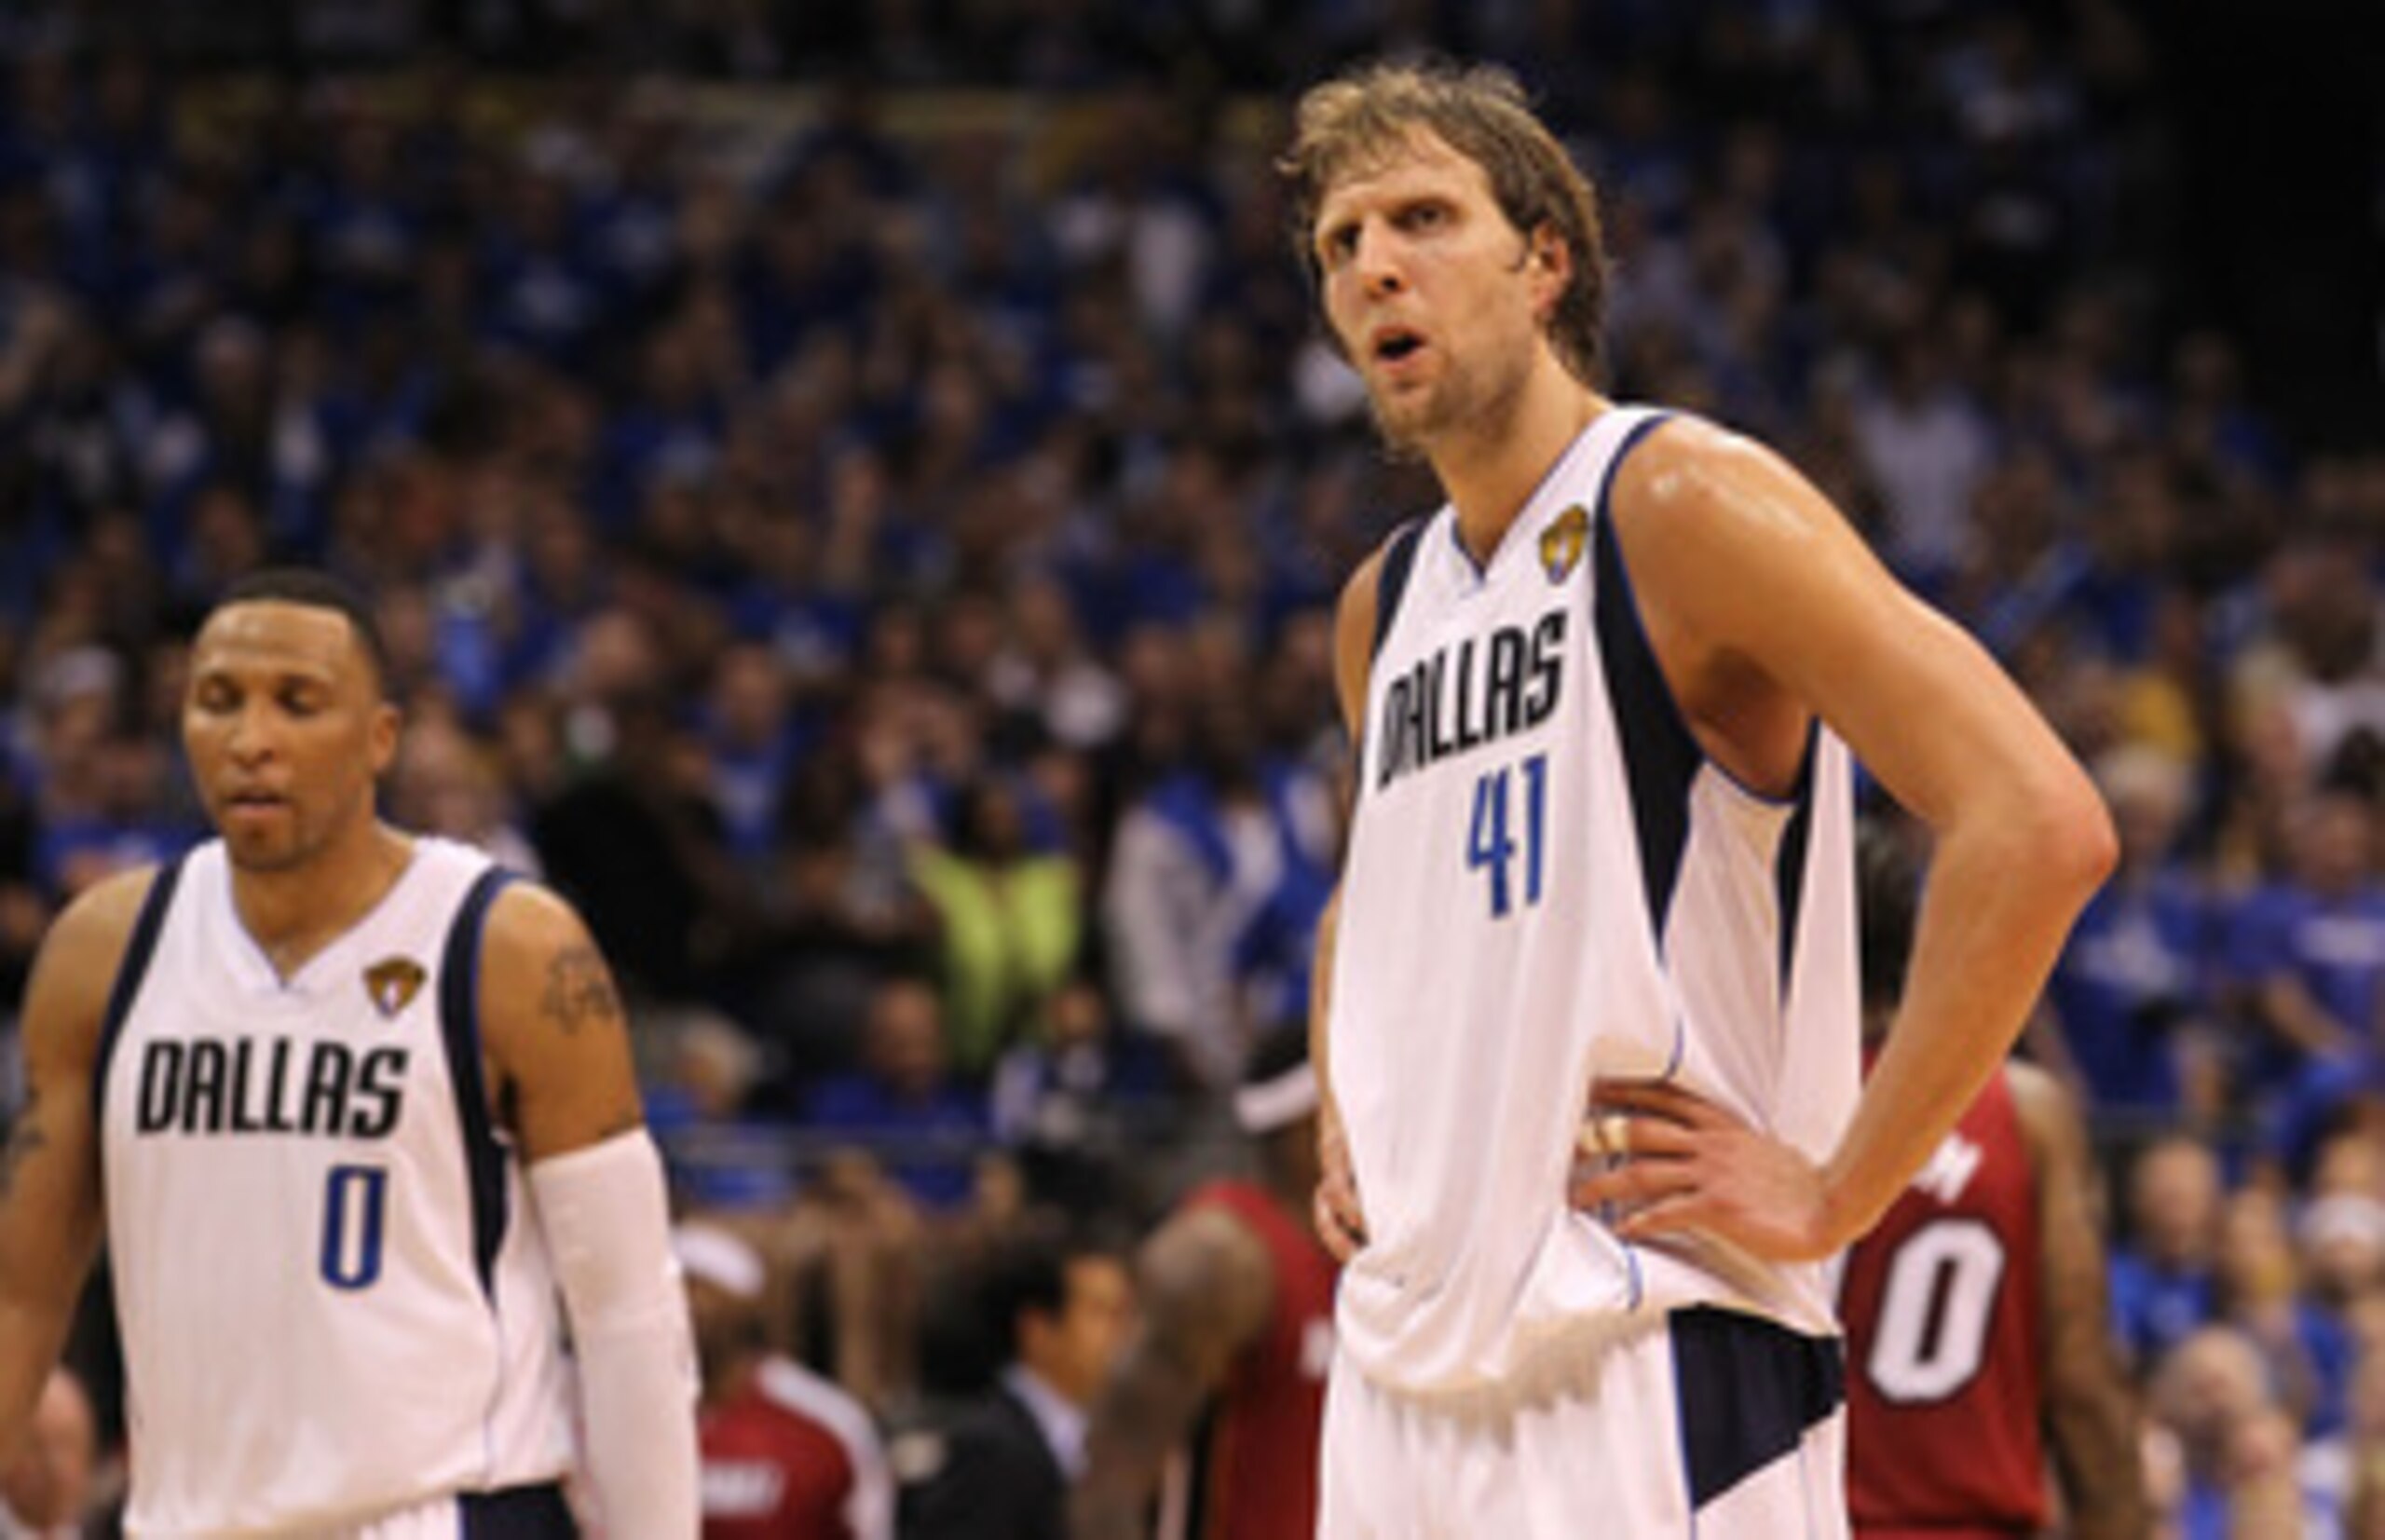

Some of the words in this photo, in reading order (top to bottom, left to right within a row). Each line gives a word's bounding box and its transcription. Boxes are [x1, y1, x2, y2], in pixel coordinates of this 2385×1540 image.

[1379, 608, 1568, 790] DALLAS
[1465, 753, 1548, 919] 41
[136, 1037, 410, 1140] DALLAS
[320, 1164, 388, 1291] 0
